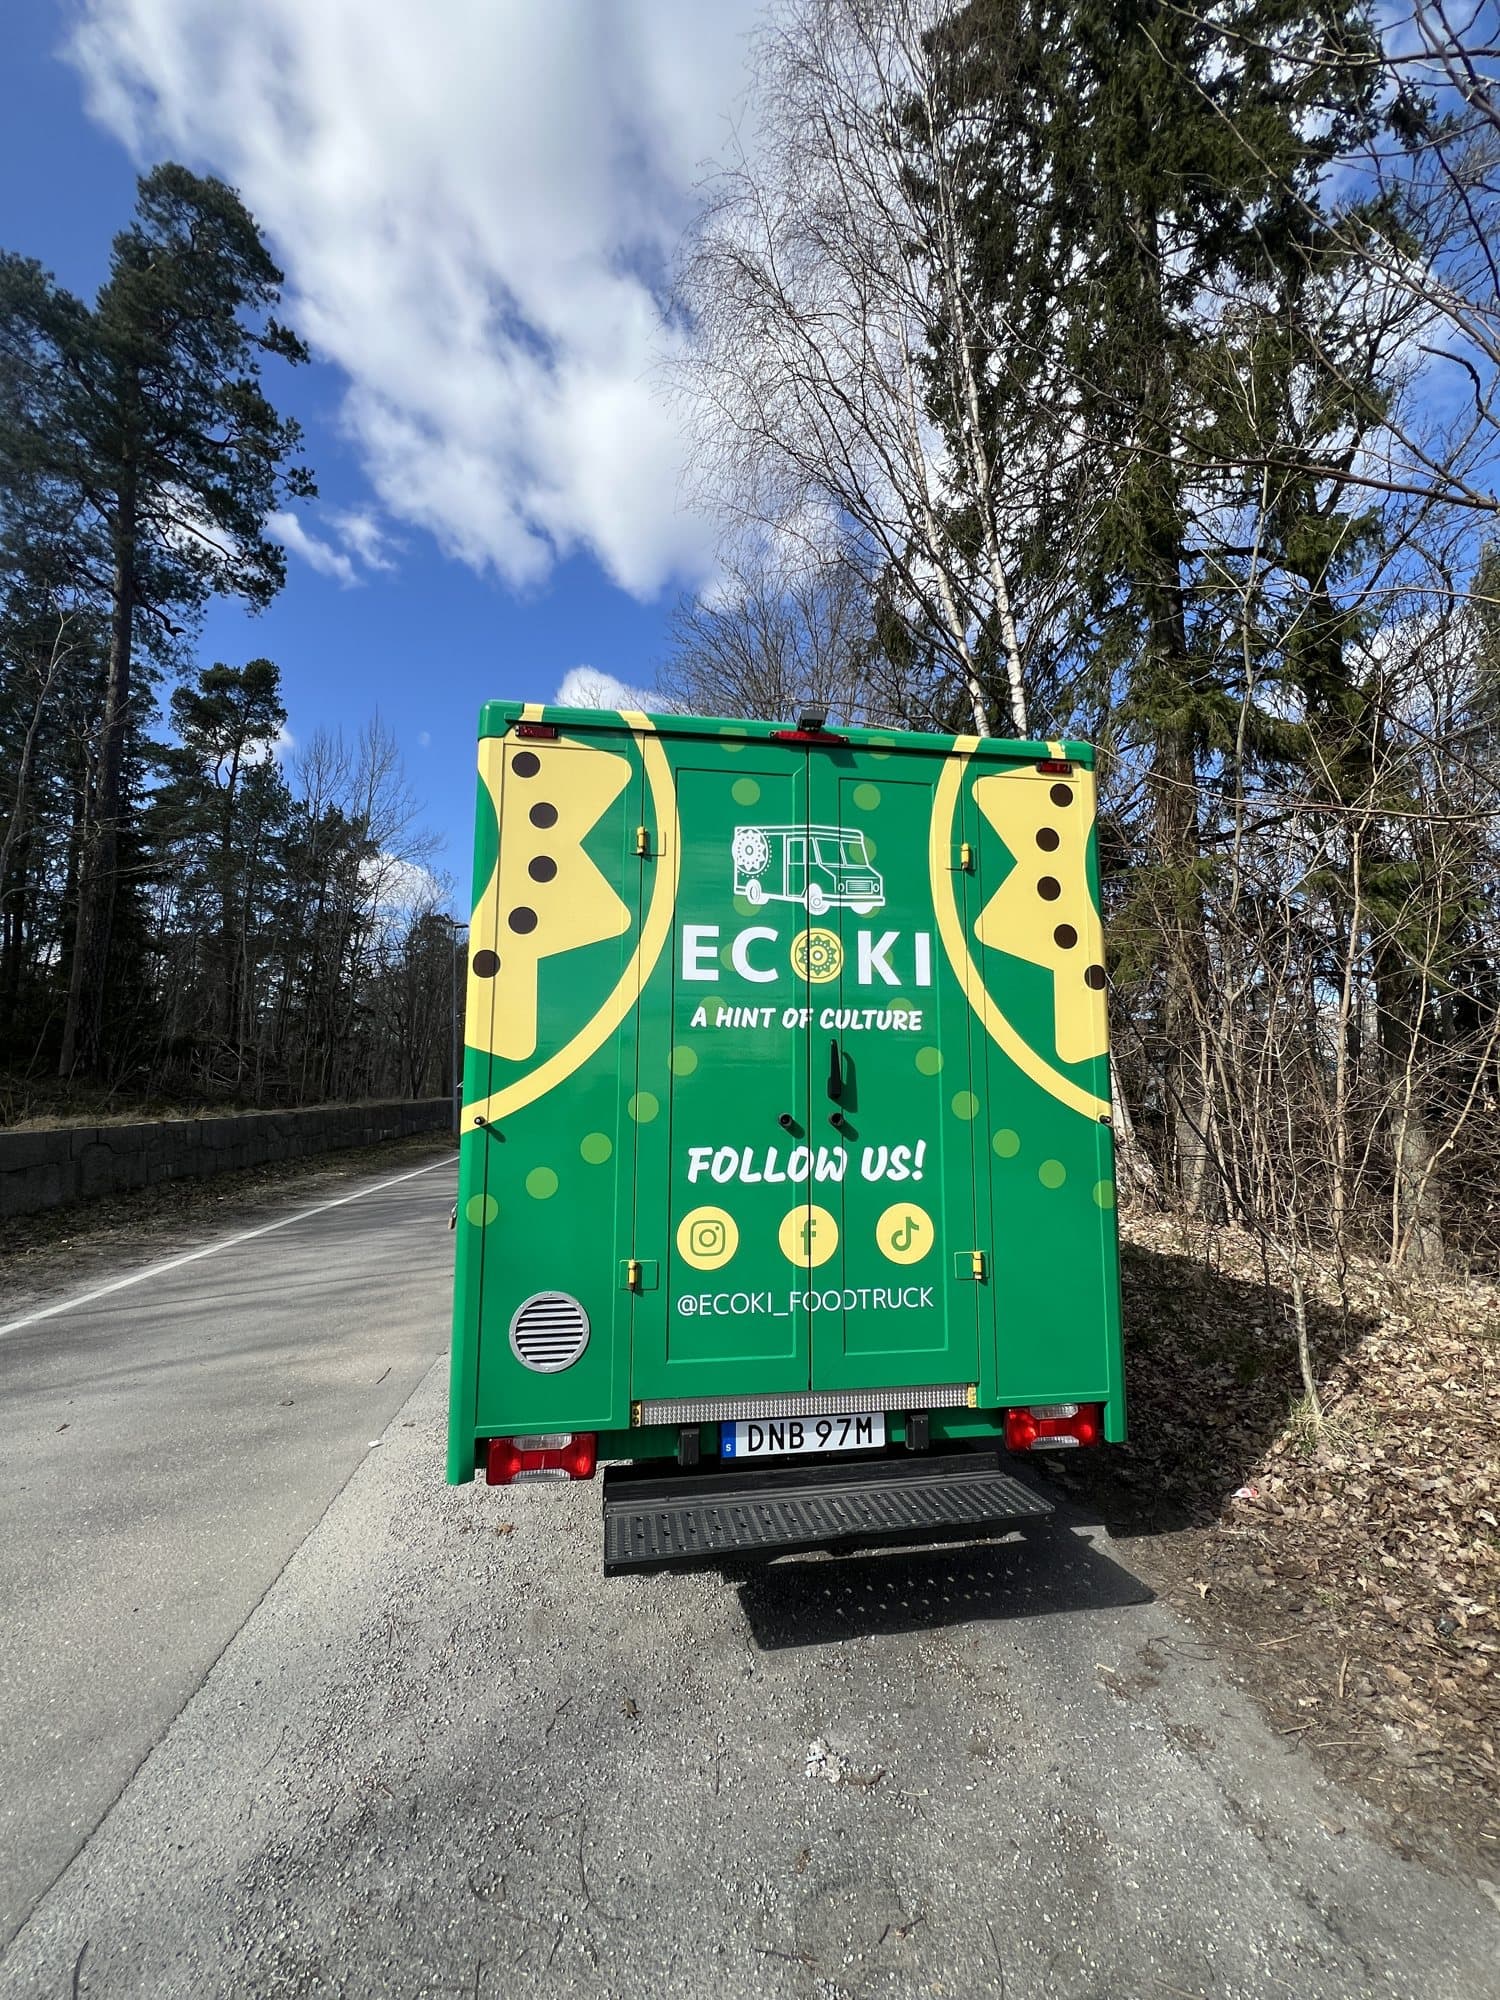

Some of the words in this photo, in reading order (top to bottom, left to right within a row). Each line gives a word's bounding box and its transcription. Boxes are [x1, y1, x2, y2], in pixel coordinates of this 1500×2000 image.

[690, 1007, 707, 1027] A
[715, 1007, 776, 1028] HINT
[782, 1008, 813, 1028] OF
[819, 1008, 922, 1030] CULTURE
[687, 1146, 847, 1183] FOLLOW
[861, 1139, 926, 1181] US!
[677, 1287, 934, 1317] @ECOKI_FOODTRUCK
[725, 1443, 732, 1452] S
[748, 1422, 804, 1452] DNB
[816, 1417, 873, 1447] 97M
